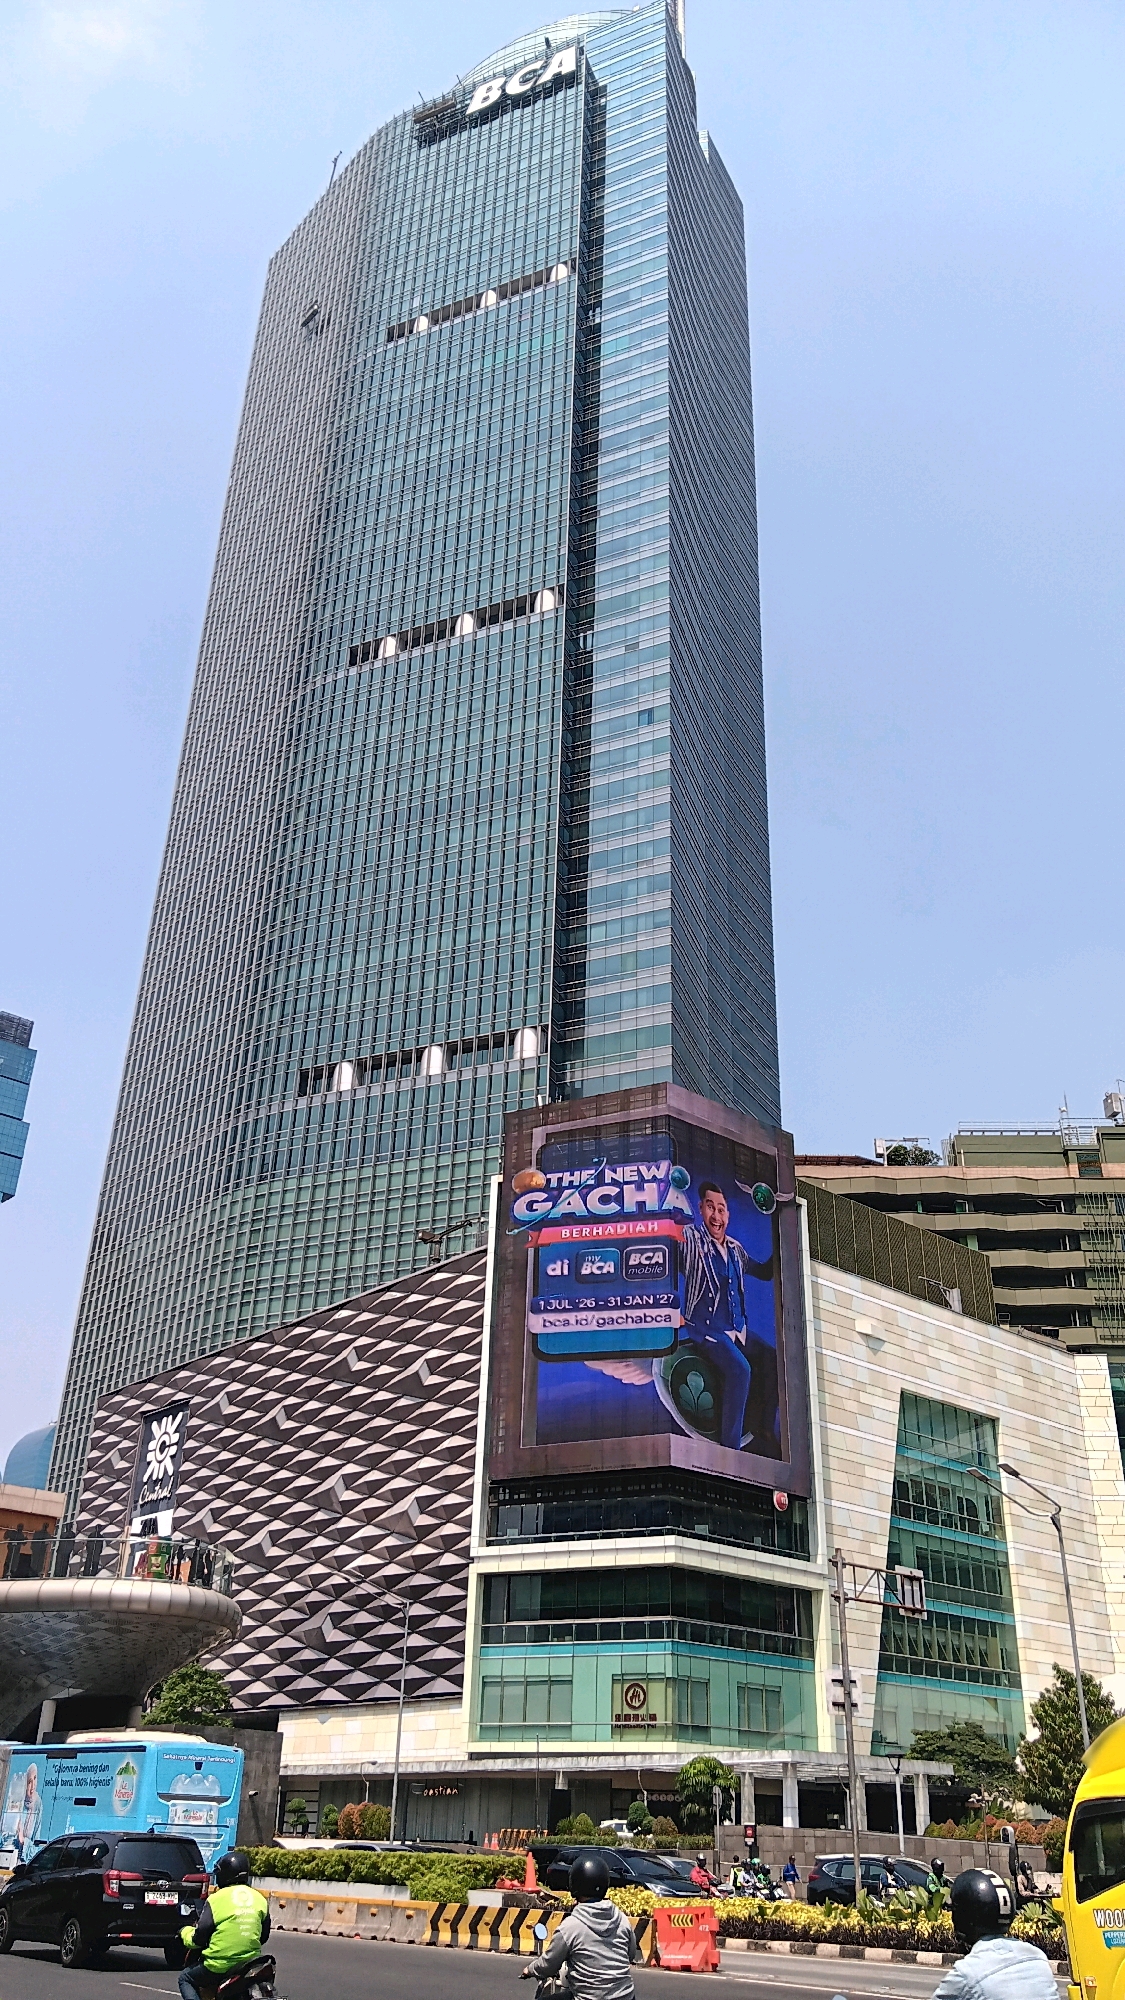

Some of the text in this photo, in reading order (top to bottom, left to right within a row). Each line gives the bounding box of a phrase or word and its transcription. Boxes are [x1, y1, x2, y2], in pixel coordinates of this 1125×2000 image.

[466, 45, 576, 115] BCA
[547, 1161, 671, 1188] THE NEW
[513, 1183, 693, 1221] GACHA
[561, 1222, 659, 1239] BERHADIAH
[585, 1254, 602, 1263] my
[628, 1251, 664, 1266] BCA
[546, 1260, 569, 1276] di
[581, 1261, 615, 1275] BCA
[627, 1265, 664, 1275] mobile
[538, 1300, 545, 1310] 1
[547, 1299, 574, 1310] JUL
[607, 1296, 622, 1308] 31
[623, 1295, 654, 1307] JAN
[656, 1294, 675, 1305] '27
[541, 1313, 673, 1329] bca.id/gachabca
[139, 1475, 175, 1504] Central
